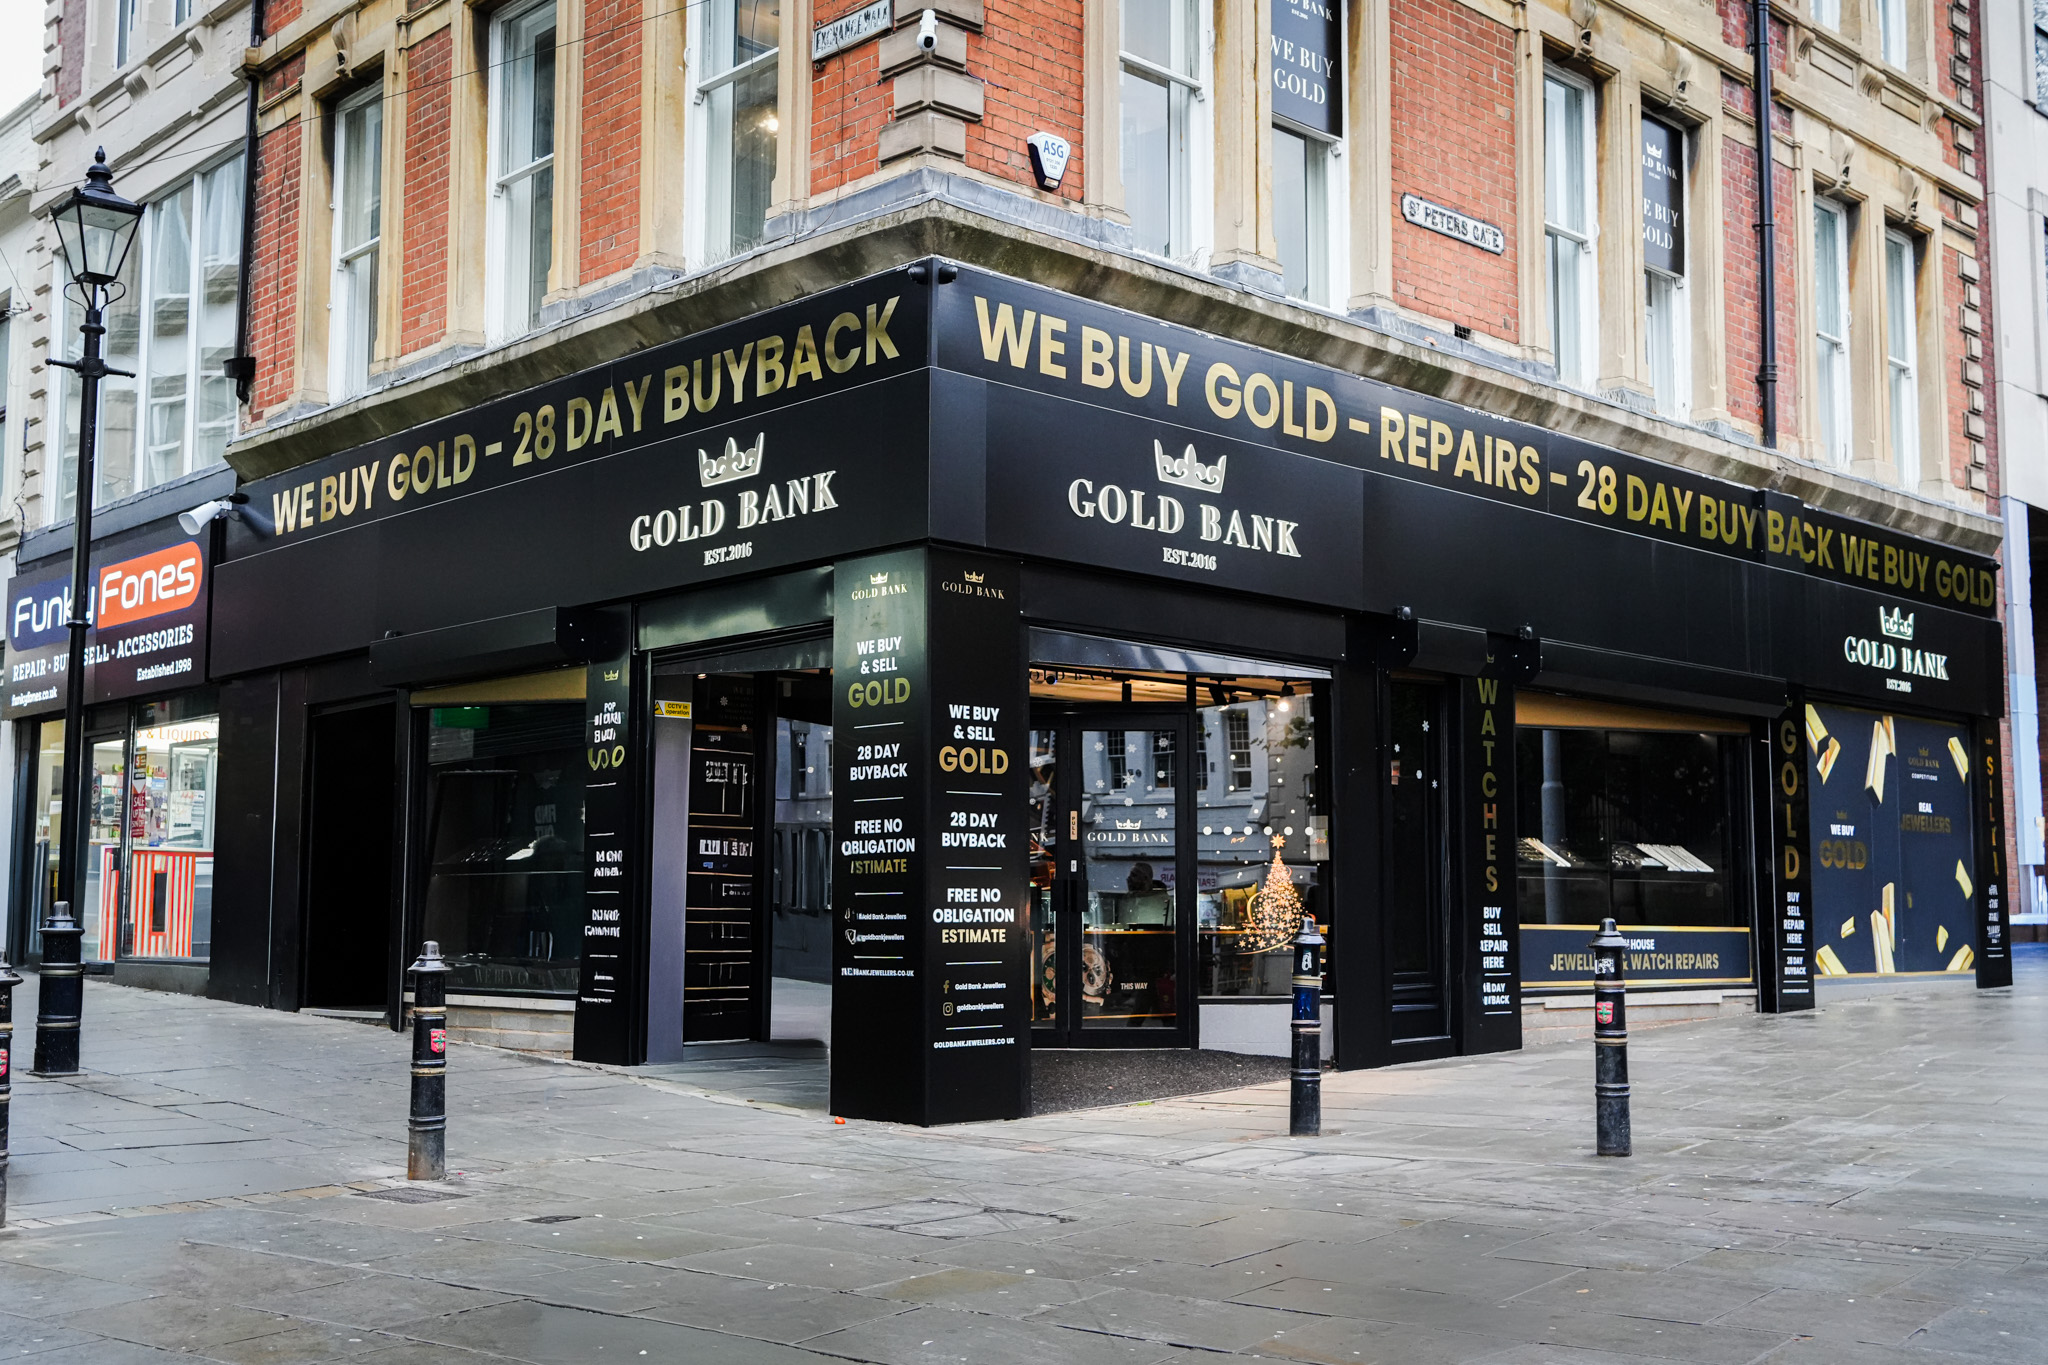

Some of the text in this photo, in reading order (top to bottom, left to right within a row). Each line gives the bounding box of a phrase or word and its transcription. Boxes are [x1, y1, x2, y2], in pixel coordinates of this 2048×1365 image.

[1302, 0, 1333, 21] BANK
[1271, 35, 1333, 78] WE BUY
[1274, 68, 1326, 105] GOLD
[1043, 140, 1064, 158] ASG
[1656, 161, 1678, 180] BANK
[1643, 197, 1679, 228] E BUY
[1424, 206, 1469, 237] PETERS
[1472, 225, 1500, 249] GATE
[272, 480, 314, 537] WE
[320, 460, 379, 521] BUY
[387, 432, 477, 502] GOLD
[512, 404, 557, 468] 28
[566, 375, 652, 453] DAY
[663, 295, 901, 425] BUYBACK
[973, 295, 1068, 380] WE
[1080, 324, 1191, 407] BUY
[1204, 361, 1338, 444] GOLD
[1379, 406, 1541, 496] REPAIRS
[1576, 459, 1617, 516] 28
[1625, 474, 1694, 533] DAY
[1699, 494, 1759, 551] BUY
[1767, 510, 1835, 570] BACK
[1840, 532, 1880, 581] WE
[1884, 543, 1935, 594] BUY
[1934, 558, 1995, 608] GOLD
[629, 469, 840, 553] GOLD BANK
[1067, 477, 1302, 558] GOLD BANK
[703, 540, 753, 567] EST.2016
[1162, 546, 1218, 572] EST.2016
[100, 557, 196, 615] Fones
[851, 583, 908, 601] GOLD BANK
[942, 581, 1005, 600] GOLD BANK
[13, 658, 46, 682] REPAIR
[53, 652, 70, 672] BU
[116, 623, 194, 660] ACCESSORIES
[857, 636, 902, 655] WE BUY
[860, 657, 898, 674] & SELL
[1843, 635, 1950, 681] GOLD BANK
[136, 657, 192, 682] Established 1998
[848, 677, 911, 708] GOLD
[949, 703, 1000, 722] WE BUY
[953, 724, 995, 741] & SELL
[857, 743, 900, 760] 28 DAY
[939, 746, 1009, 775] GOLD
[850, 763, 908, 781] BUYBACK
[1477, 677, 1499, 892] WATCHES
[1780, 719, 1800, 880] GOLD
[1918, 802, 1933, 813] REAL
[854, 818, 903, 834] FREE NO
[950, 811, 998, 828] 28 DAY
[1900, 813, 1951, 834] JEWELLERS
[1087, 832, 1169, 843] GOLD BANK
[1830, 823, 1855, 837] WE BUY
[841, 838, 915, 856] OBLIGATION
[941, 832, 1006, 848] BUYBACK
[1818, 840, 1868, 870] GOLD
[947, 888, 1001, 903] FREE NO
[1787, 892, 1800, 903] BUY
[933, 908, 1015, 923] OBLIGATION
[1483, 906, 1502, 919] BUY
[1787, 906, 1801, 917] SELL
[1483, 923, 1503, 936] SELL
[1783, 919, 1805, 931] REPAIR
[941, 928, 1006, 944] ESTIMATE
[1630, 938, 1655, 950] HOUSE
[1787, 933, 1803, 944] HERE
[1483, 956, 1505, 969] HERE
[1550, 953, 1596, 972] JEWELL
[1631, 954, 1673, 970] WATCH
[1675, 953, 1719, 970] REPAIRS
[1793, 957, 1804, 965] DAY
[1784, 966, 1807, 975] BUYBACK
[954, 981, 1006, 991] Gold Bank Jewellers
[1120, 982, 1148, 990] THIS WAY
[1492, 983, 1506, 993] DAY
